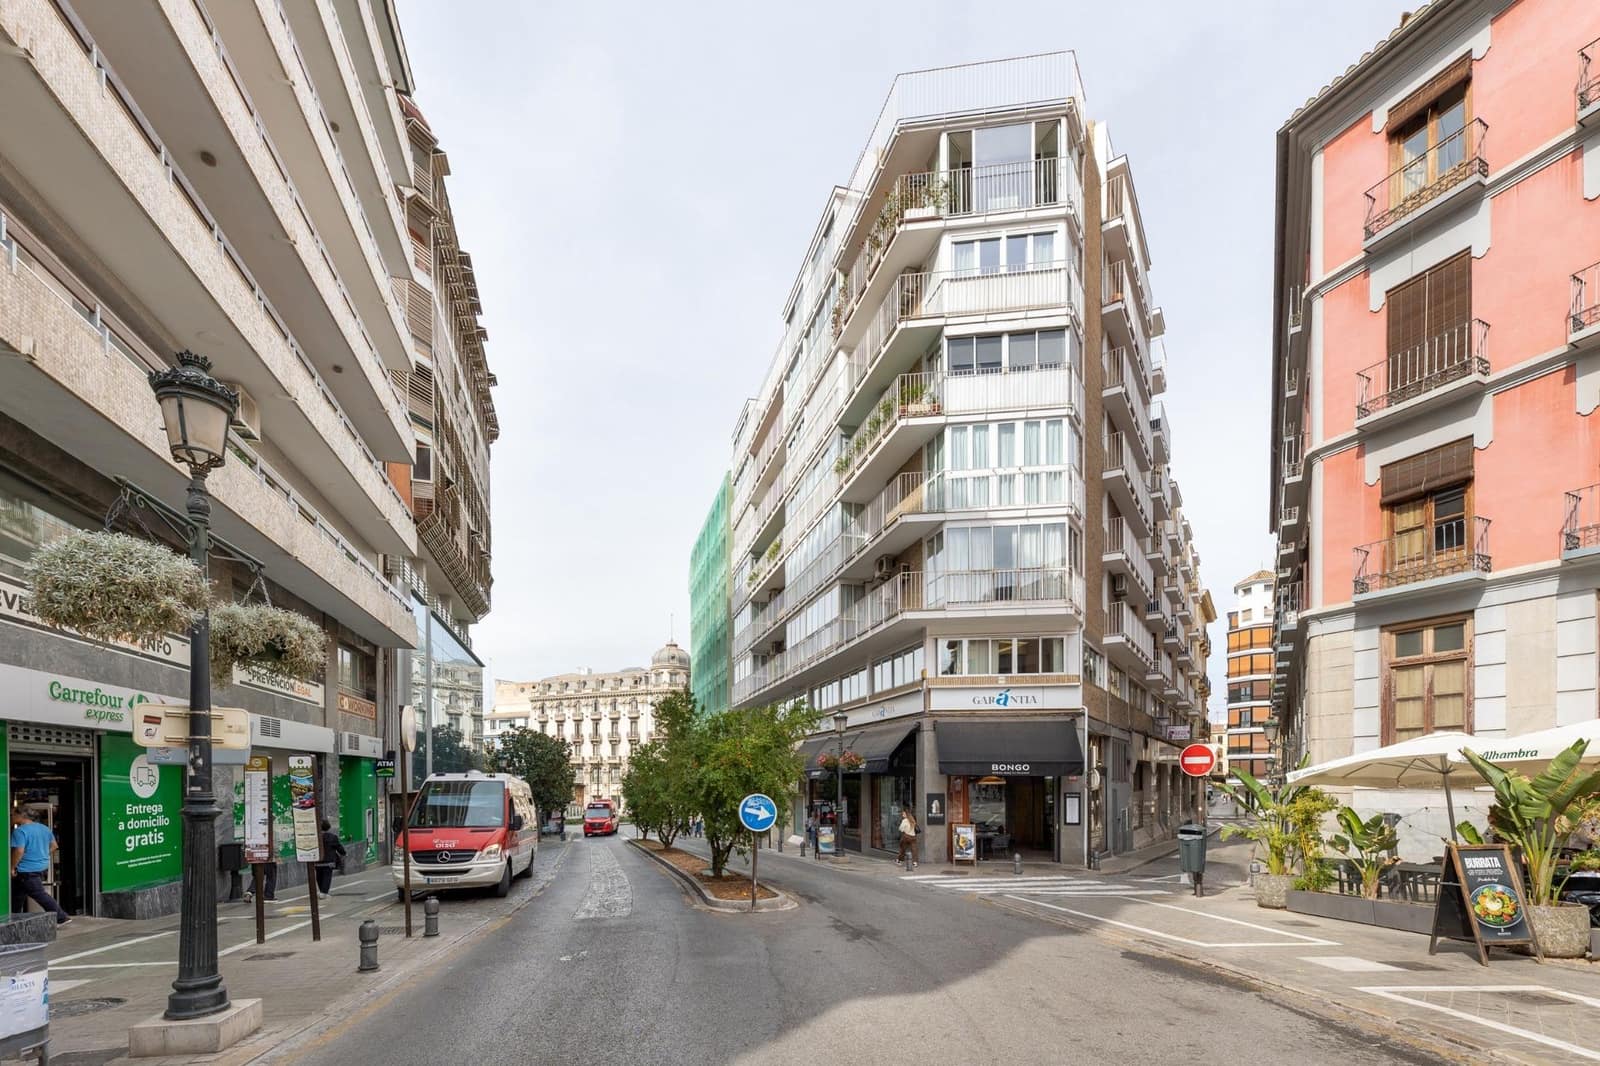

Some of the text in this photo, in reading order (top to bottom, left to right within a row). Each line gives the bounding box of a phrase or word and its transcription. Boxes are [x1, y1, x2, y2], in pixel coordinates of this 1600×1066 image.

[49, 680, 124, 709] Carrefour
[86, 708, 124, 724] express
[991, 763, 1030, 771] BONGO
[126, 803, 163, 815] Entrega
[118, 815, 170, 831] a domicilio
[125, 828, 165, 852] gratis
[1464, 857, 1502, 869] BURRATA
